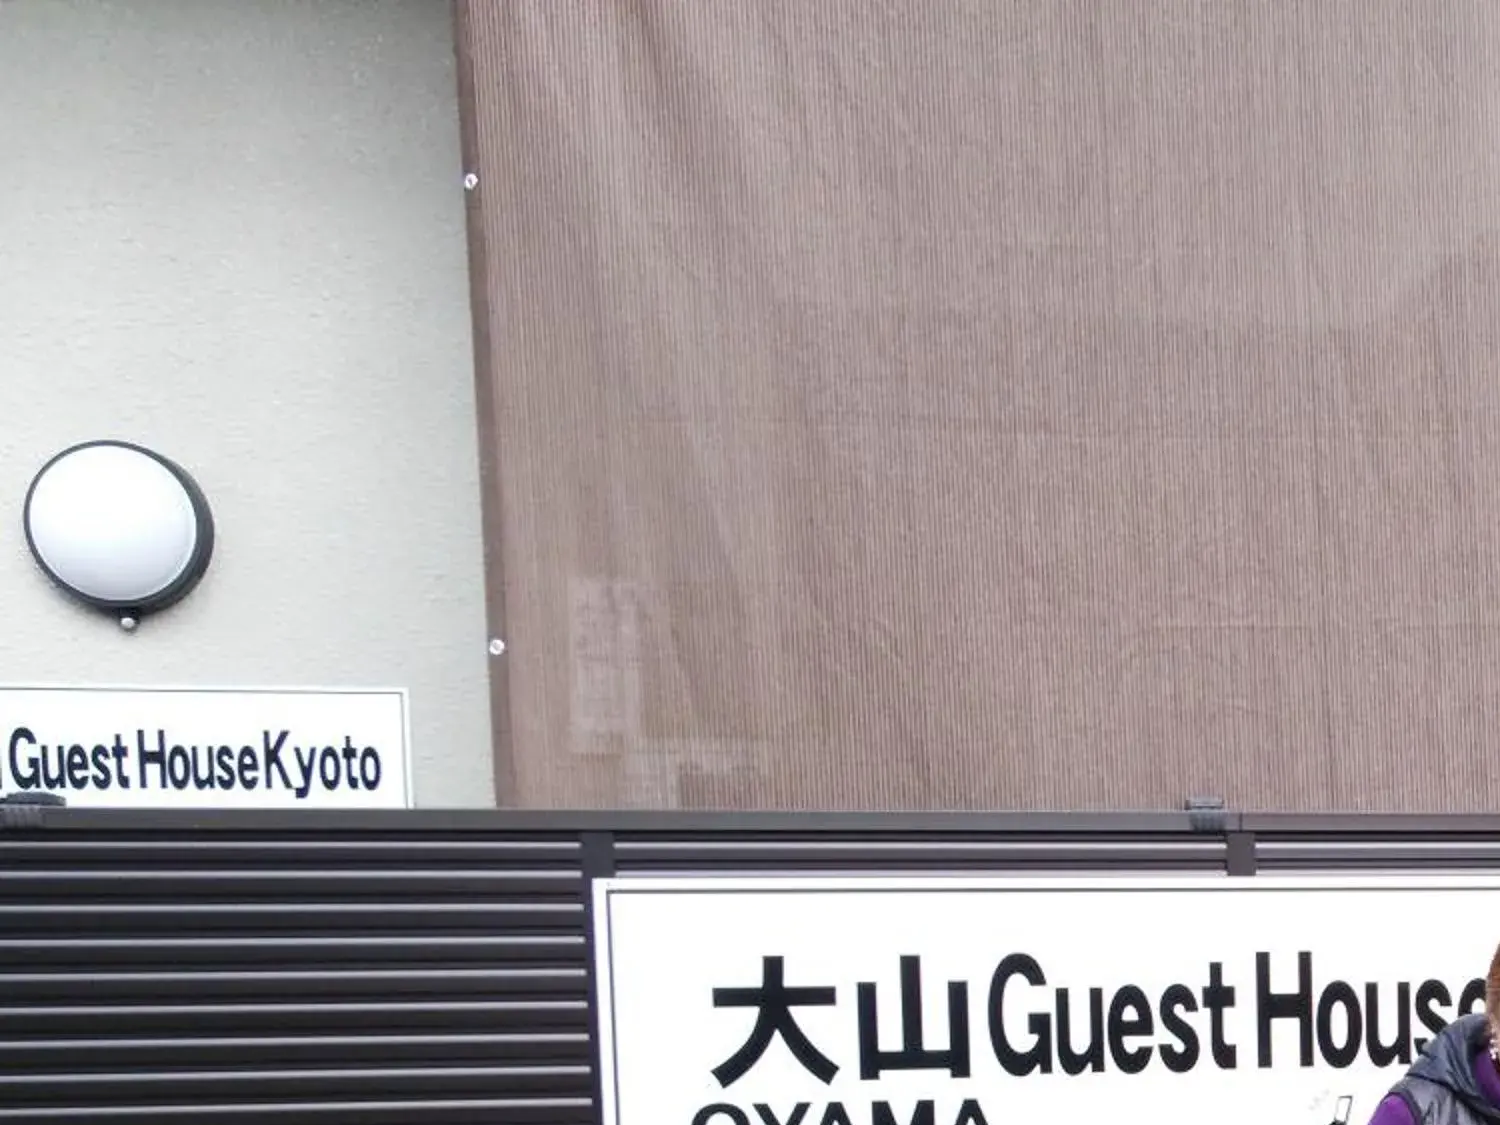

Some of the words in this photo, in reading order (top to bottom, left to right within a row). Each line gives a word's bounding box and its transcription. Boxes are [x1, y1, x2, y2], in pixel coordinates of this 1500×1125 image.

[9, 727, 130, 790] Guest
[137, 729, 259, 791] House
[263, 730, 381, 799] Kyoto
[711, 955, 971, 1088] 大山
[987, 953, 1237, 1077] Guest
